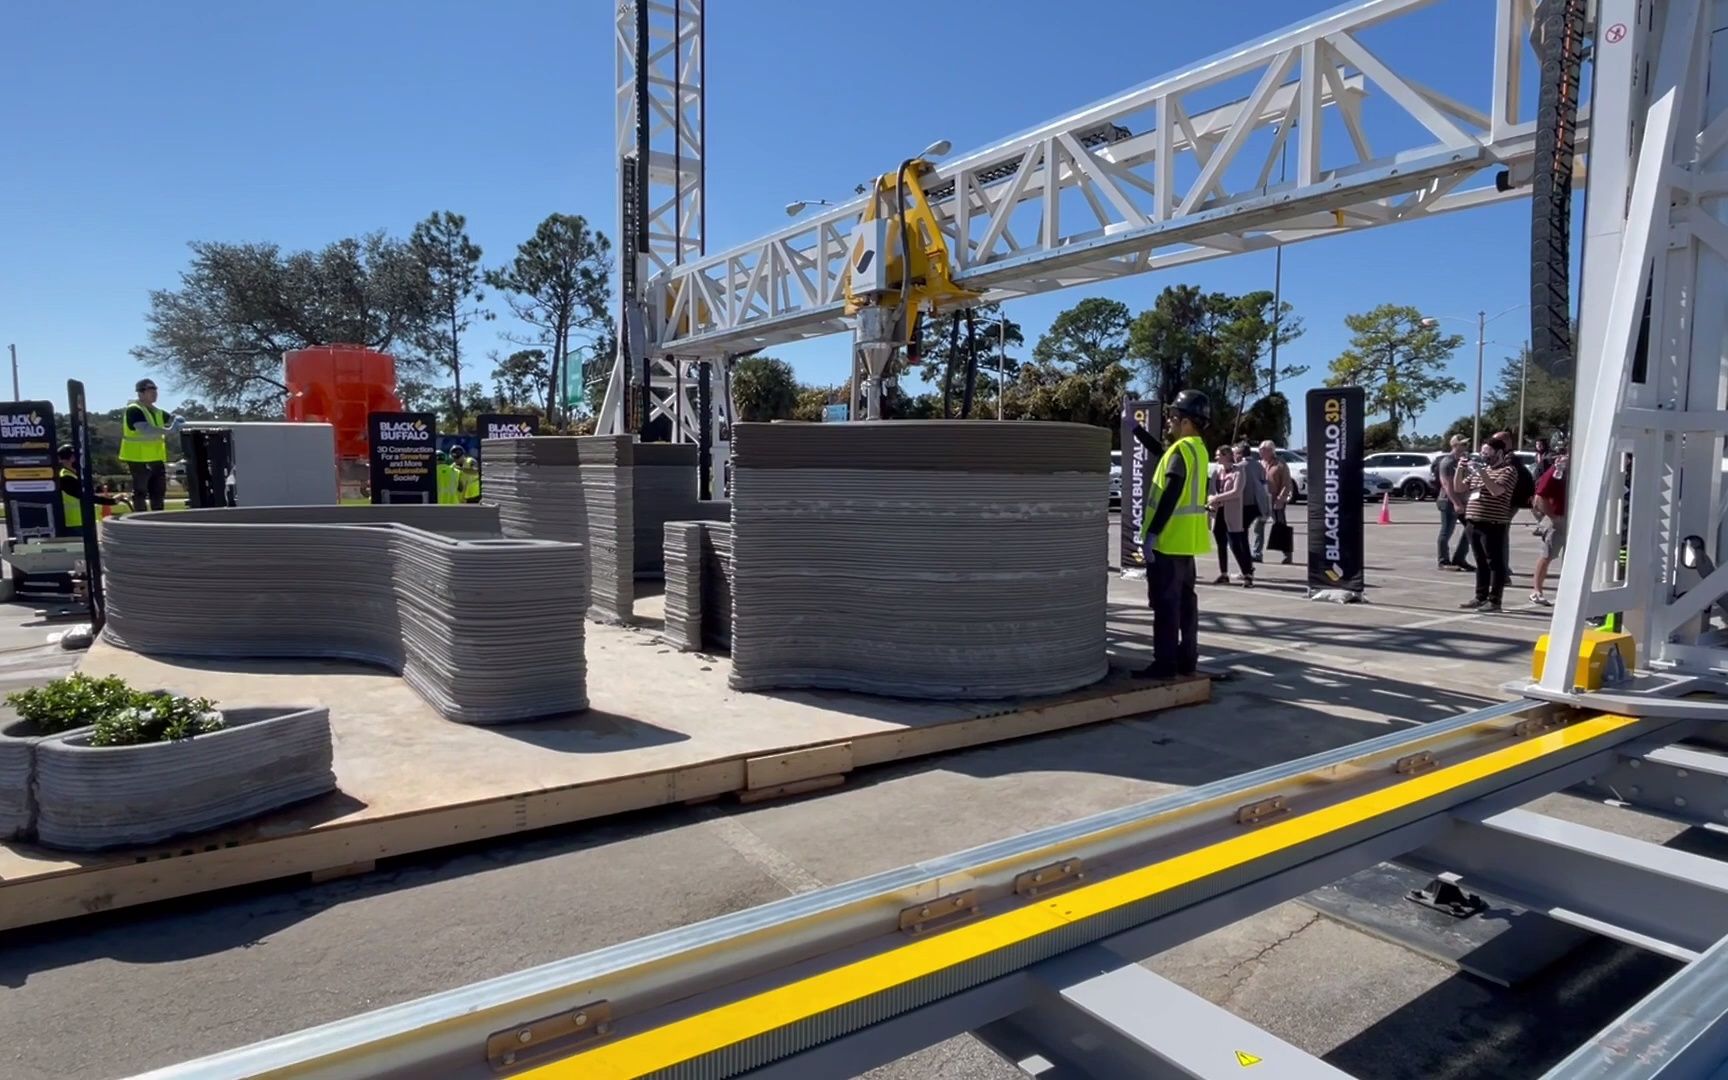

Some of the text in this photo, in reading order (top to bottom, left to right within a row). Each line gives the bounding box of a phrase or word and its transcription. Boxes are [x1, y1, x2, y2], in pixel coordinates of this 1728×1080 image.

[0, 414, 31, 425] BLACK
[1, 425, 45, 438] BUFFALO
[380, 422, 415, 431] BLACK
[488, 423, 520, 432] BLACK
[381, 431, 429, 440] BUFFALO
[1325, 399, 1340, 561] BLACK BUFFALO 3D
